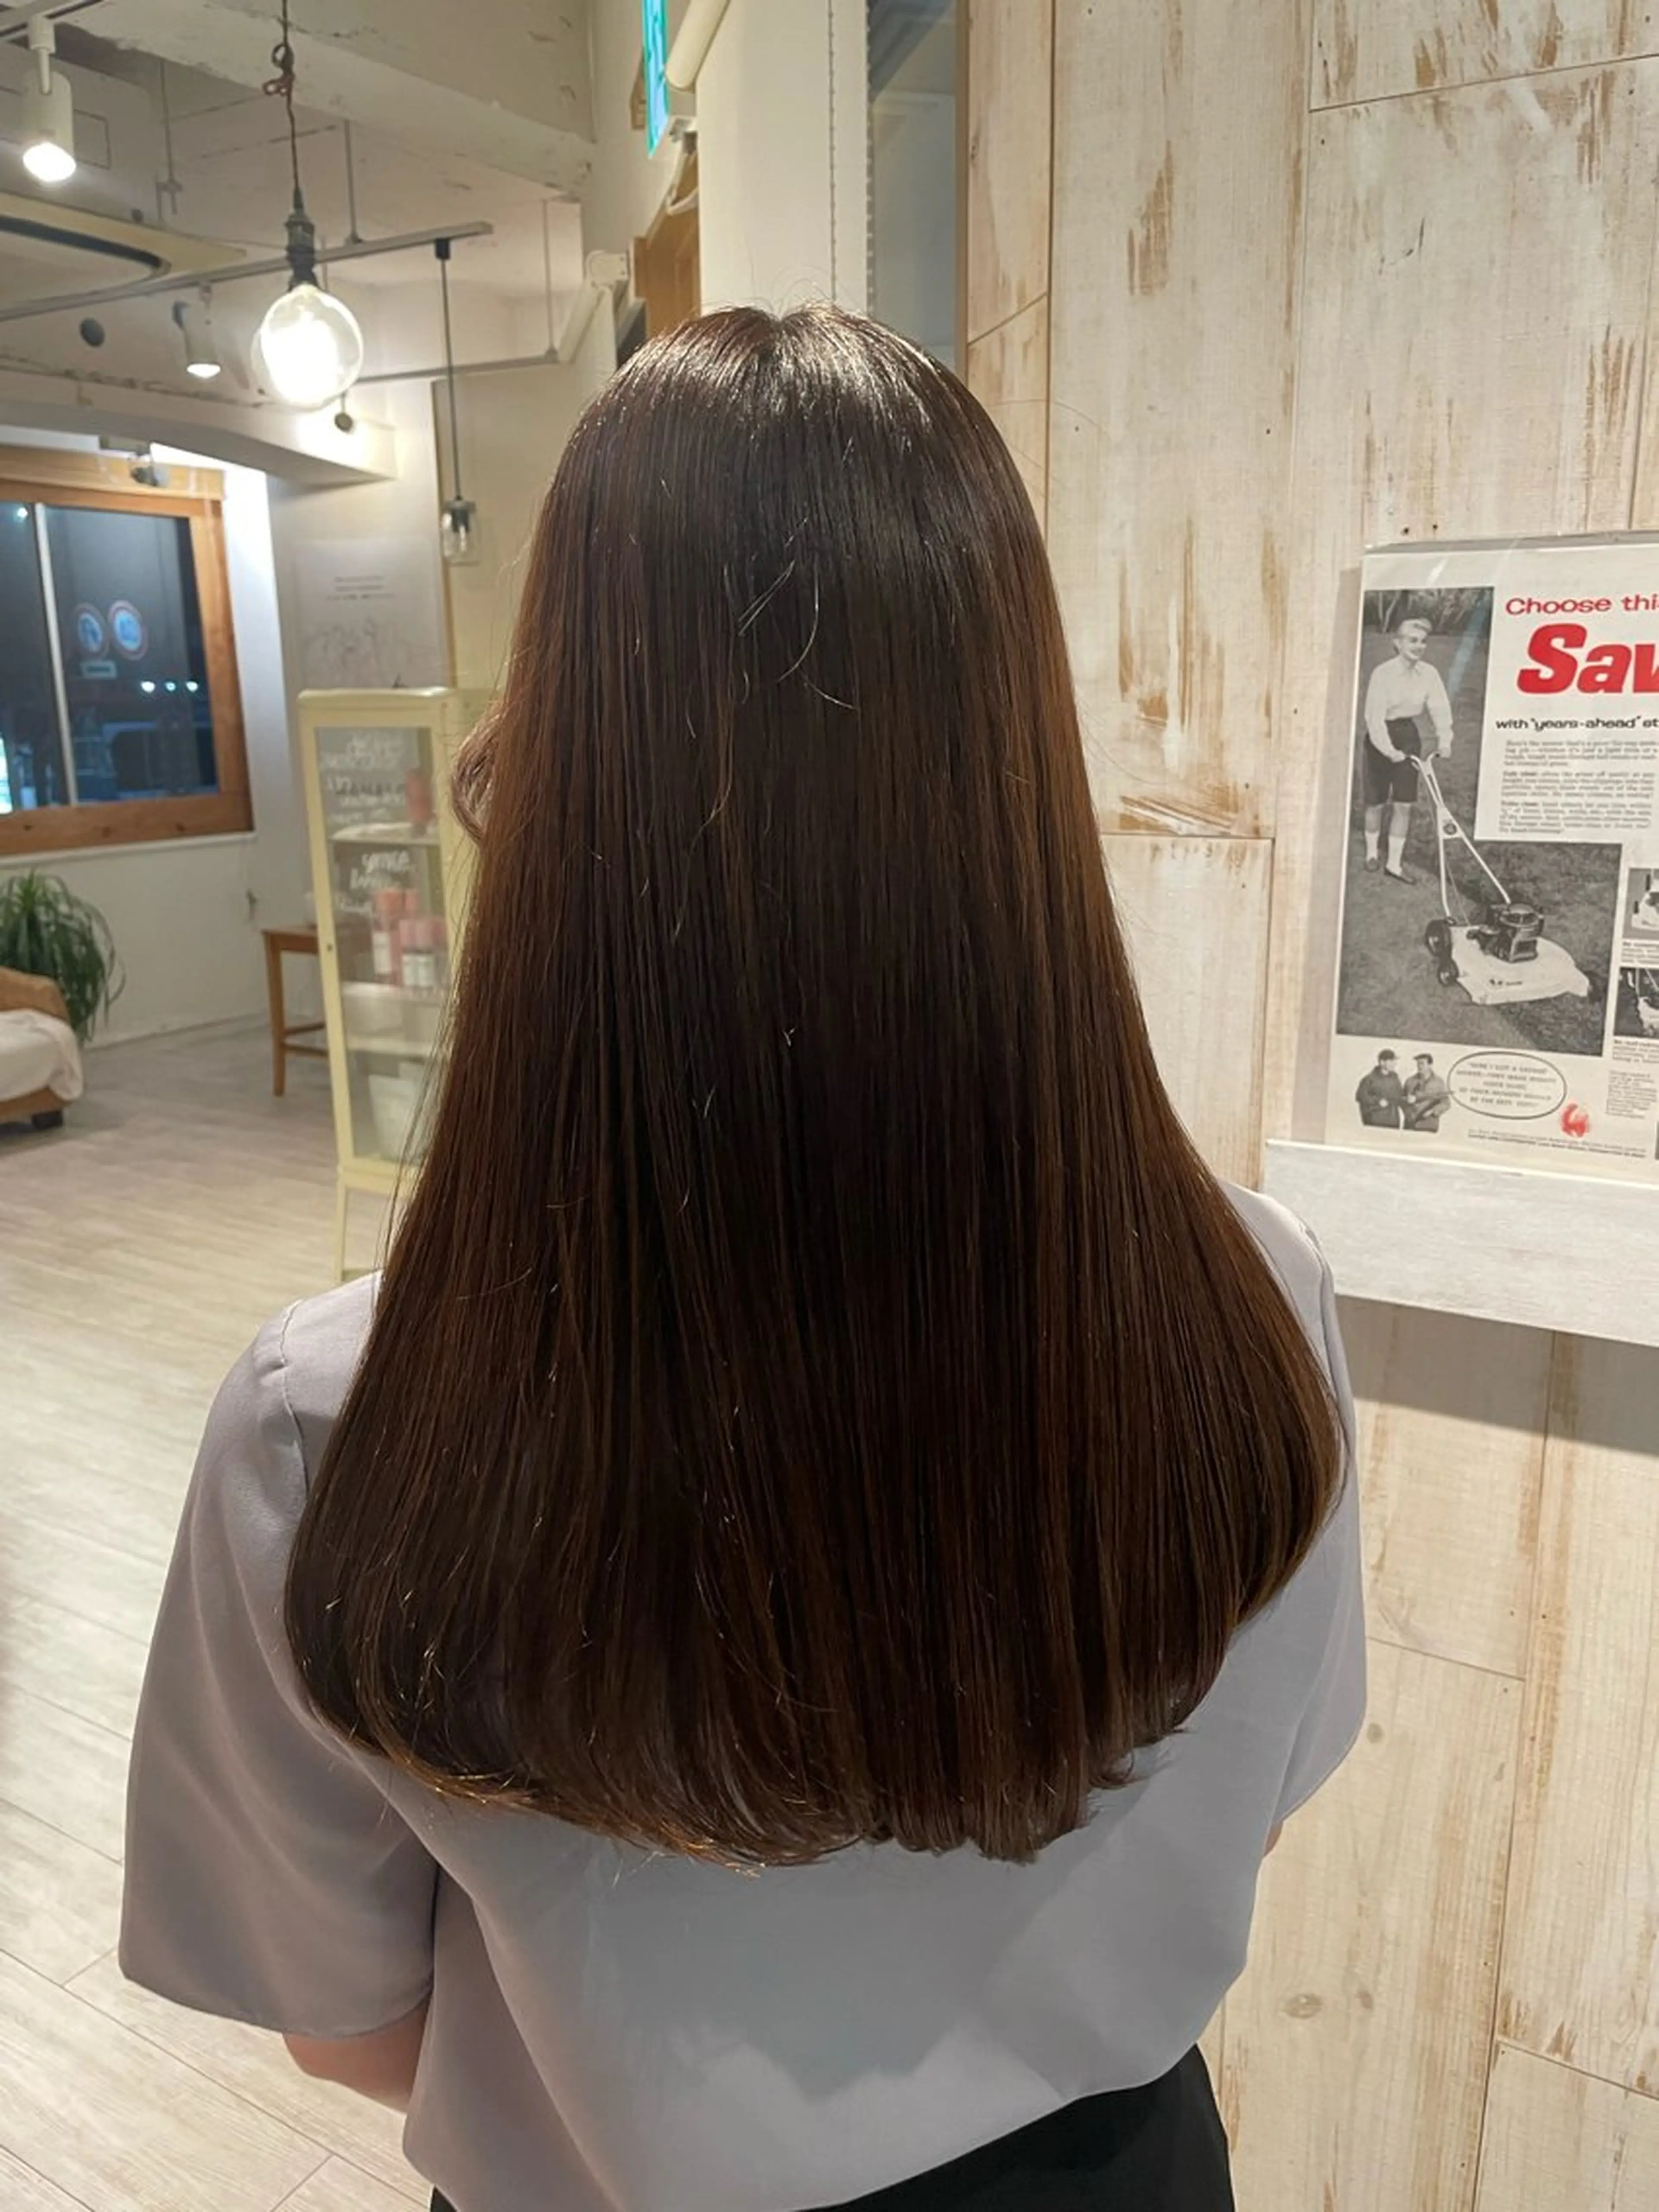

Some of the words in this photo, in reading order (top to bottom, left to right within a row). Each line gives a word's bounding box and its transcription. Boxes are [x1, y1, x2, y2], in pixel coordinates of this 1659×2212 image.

[1505, 597, 1611, 616] Choose
[1620, 593, 1659, 612] thi
[1495, 718, 1529, 729] with
